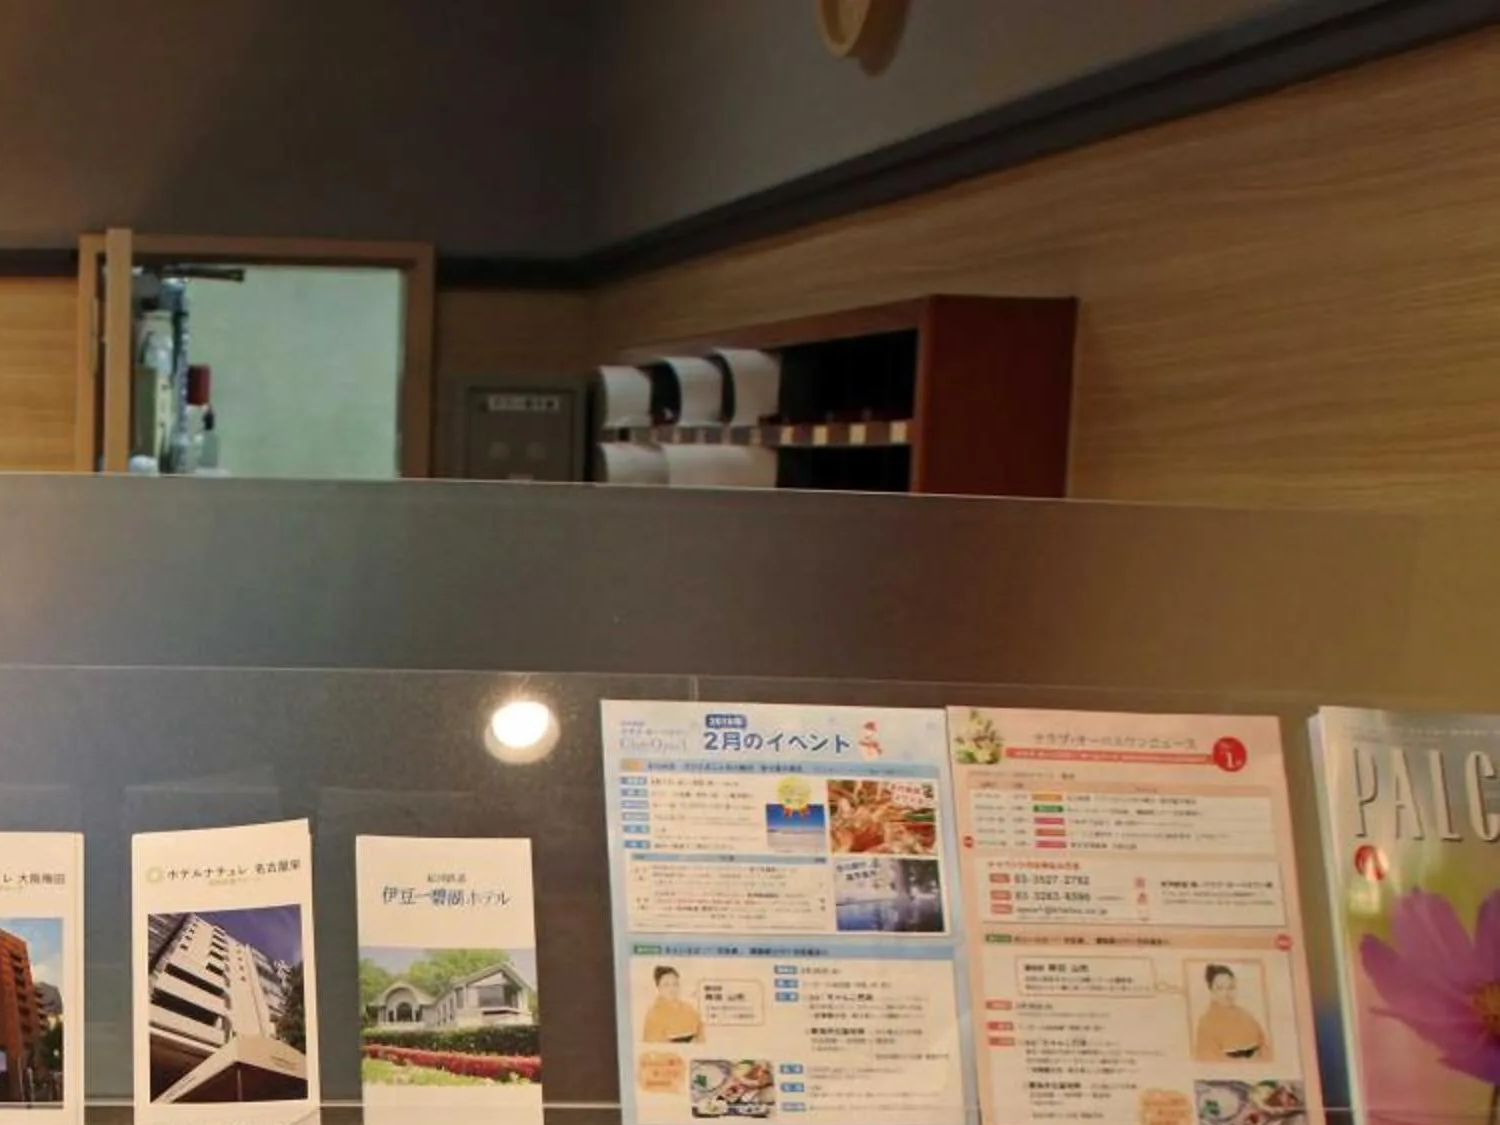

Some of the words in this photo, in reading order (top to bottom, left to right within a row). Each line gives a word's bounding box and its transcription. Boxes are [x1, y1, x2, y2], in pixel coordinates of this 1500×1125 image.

[704, 731, 850, 753] 2月のイベント
[382, 885, 512, 906] 伊豆一碧湖ホテル
